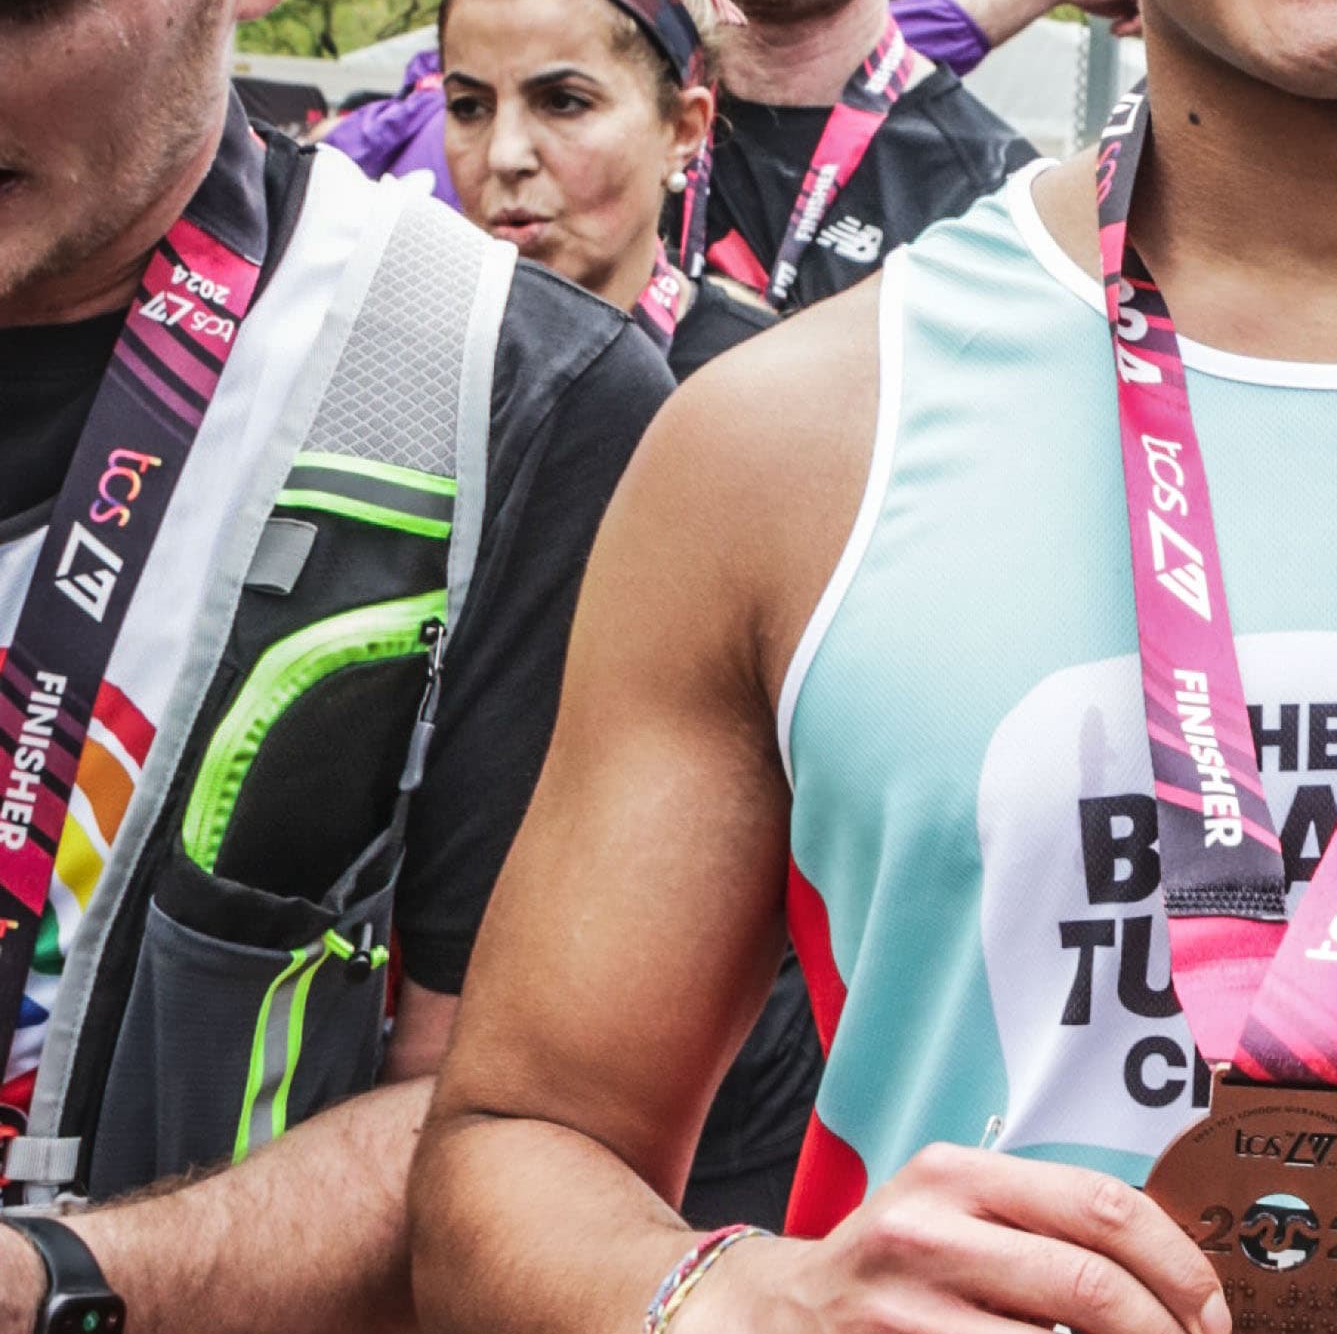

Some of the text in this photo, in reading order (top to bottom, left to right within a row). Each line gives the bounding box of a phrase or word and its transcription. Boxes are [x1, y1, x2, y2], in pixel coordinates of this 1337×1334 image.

[170, 264, 231, 305] 2024
[190, 310, 235, 343] tcs
[89, 447, 162, 529] tcs
[1141, 434, 1189, 517] tcs
[0, 670, 67, 851] FINISHER
[1173, 668, 1242, 849] FINISHER
[1234, 1128, 1283, 1160] tcs
